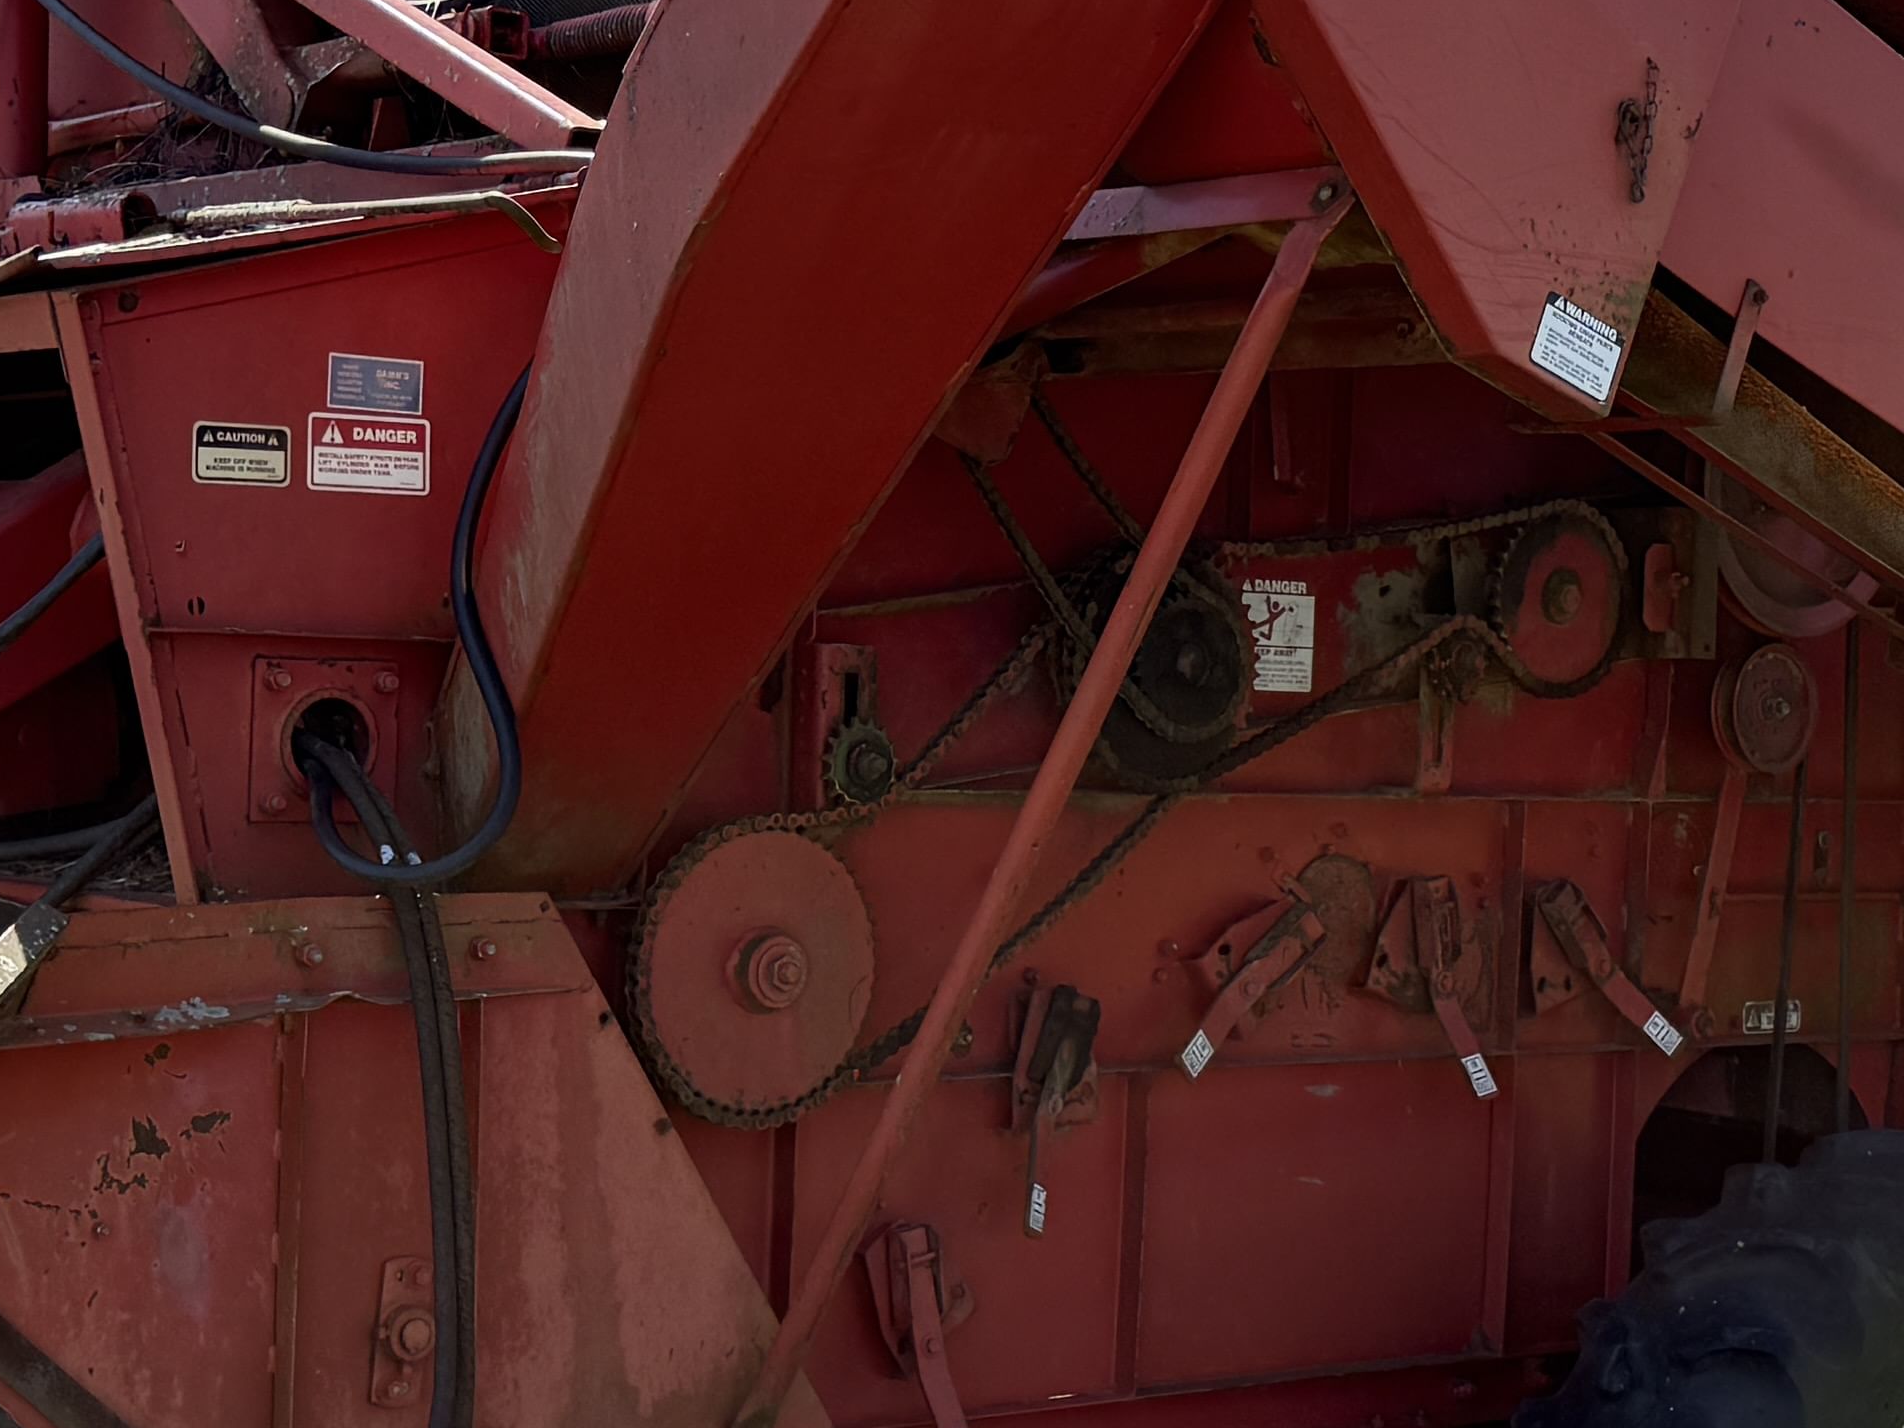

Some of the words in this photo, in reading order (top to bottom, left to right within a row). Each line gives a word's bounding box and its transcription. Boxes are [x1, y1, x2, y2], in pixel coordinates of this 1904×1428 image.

[1566, 299, 1618, 342] WARNING
[216, 431, 266, 444] CAUTION
[352, 427, 417, 444] DANGER
[1254, 579, 1307, 595] DANGER
